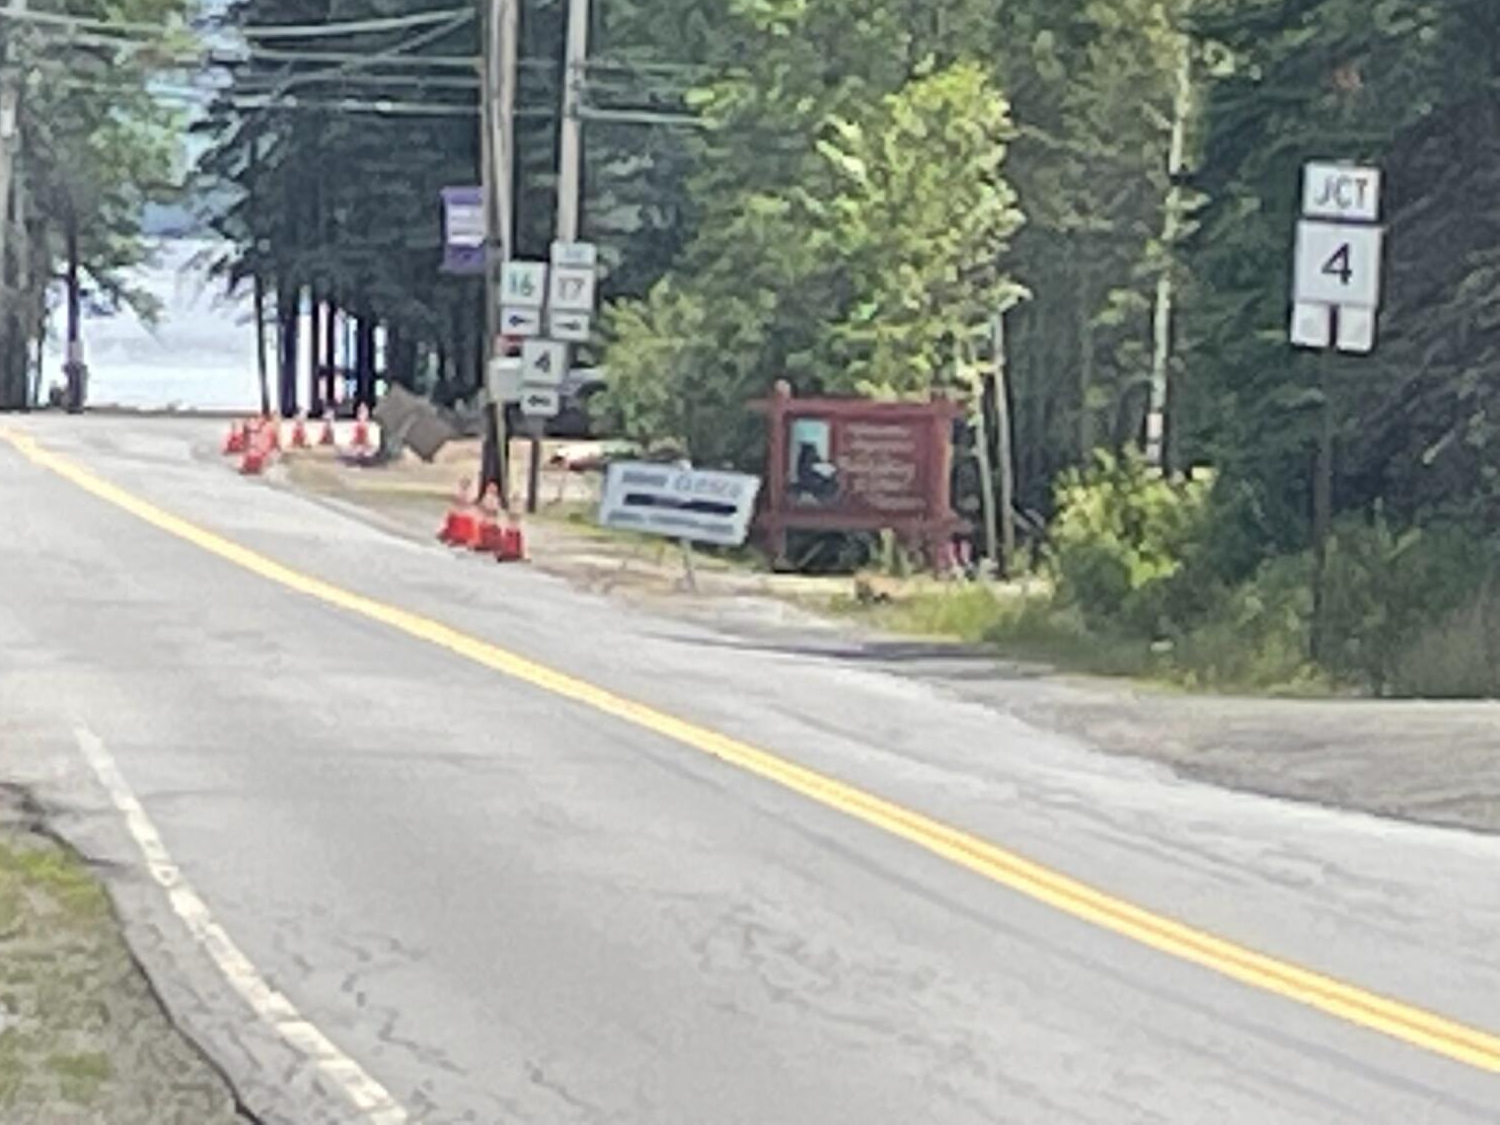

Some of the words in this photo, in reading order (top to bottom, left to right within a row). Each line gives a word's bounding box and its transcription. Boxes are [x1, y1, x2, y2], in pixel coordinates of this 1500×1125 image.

[1314, 177, 1368, 209] JCT
[1322, 242, 1353, 285] 4
[509, 272, 535, 297] 16
[558, 277, 585, 300] 17
[534, 350, 551, 373] 4
